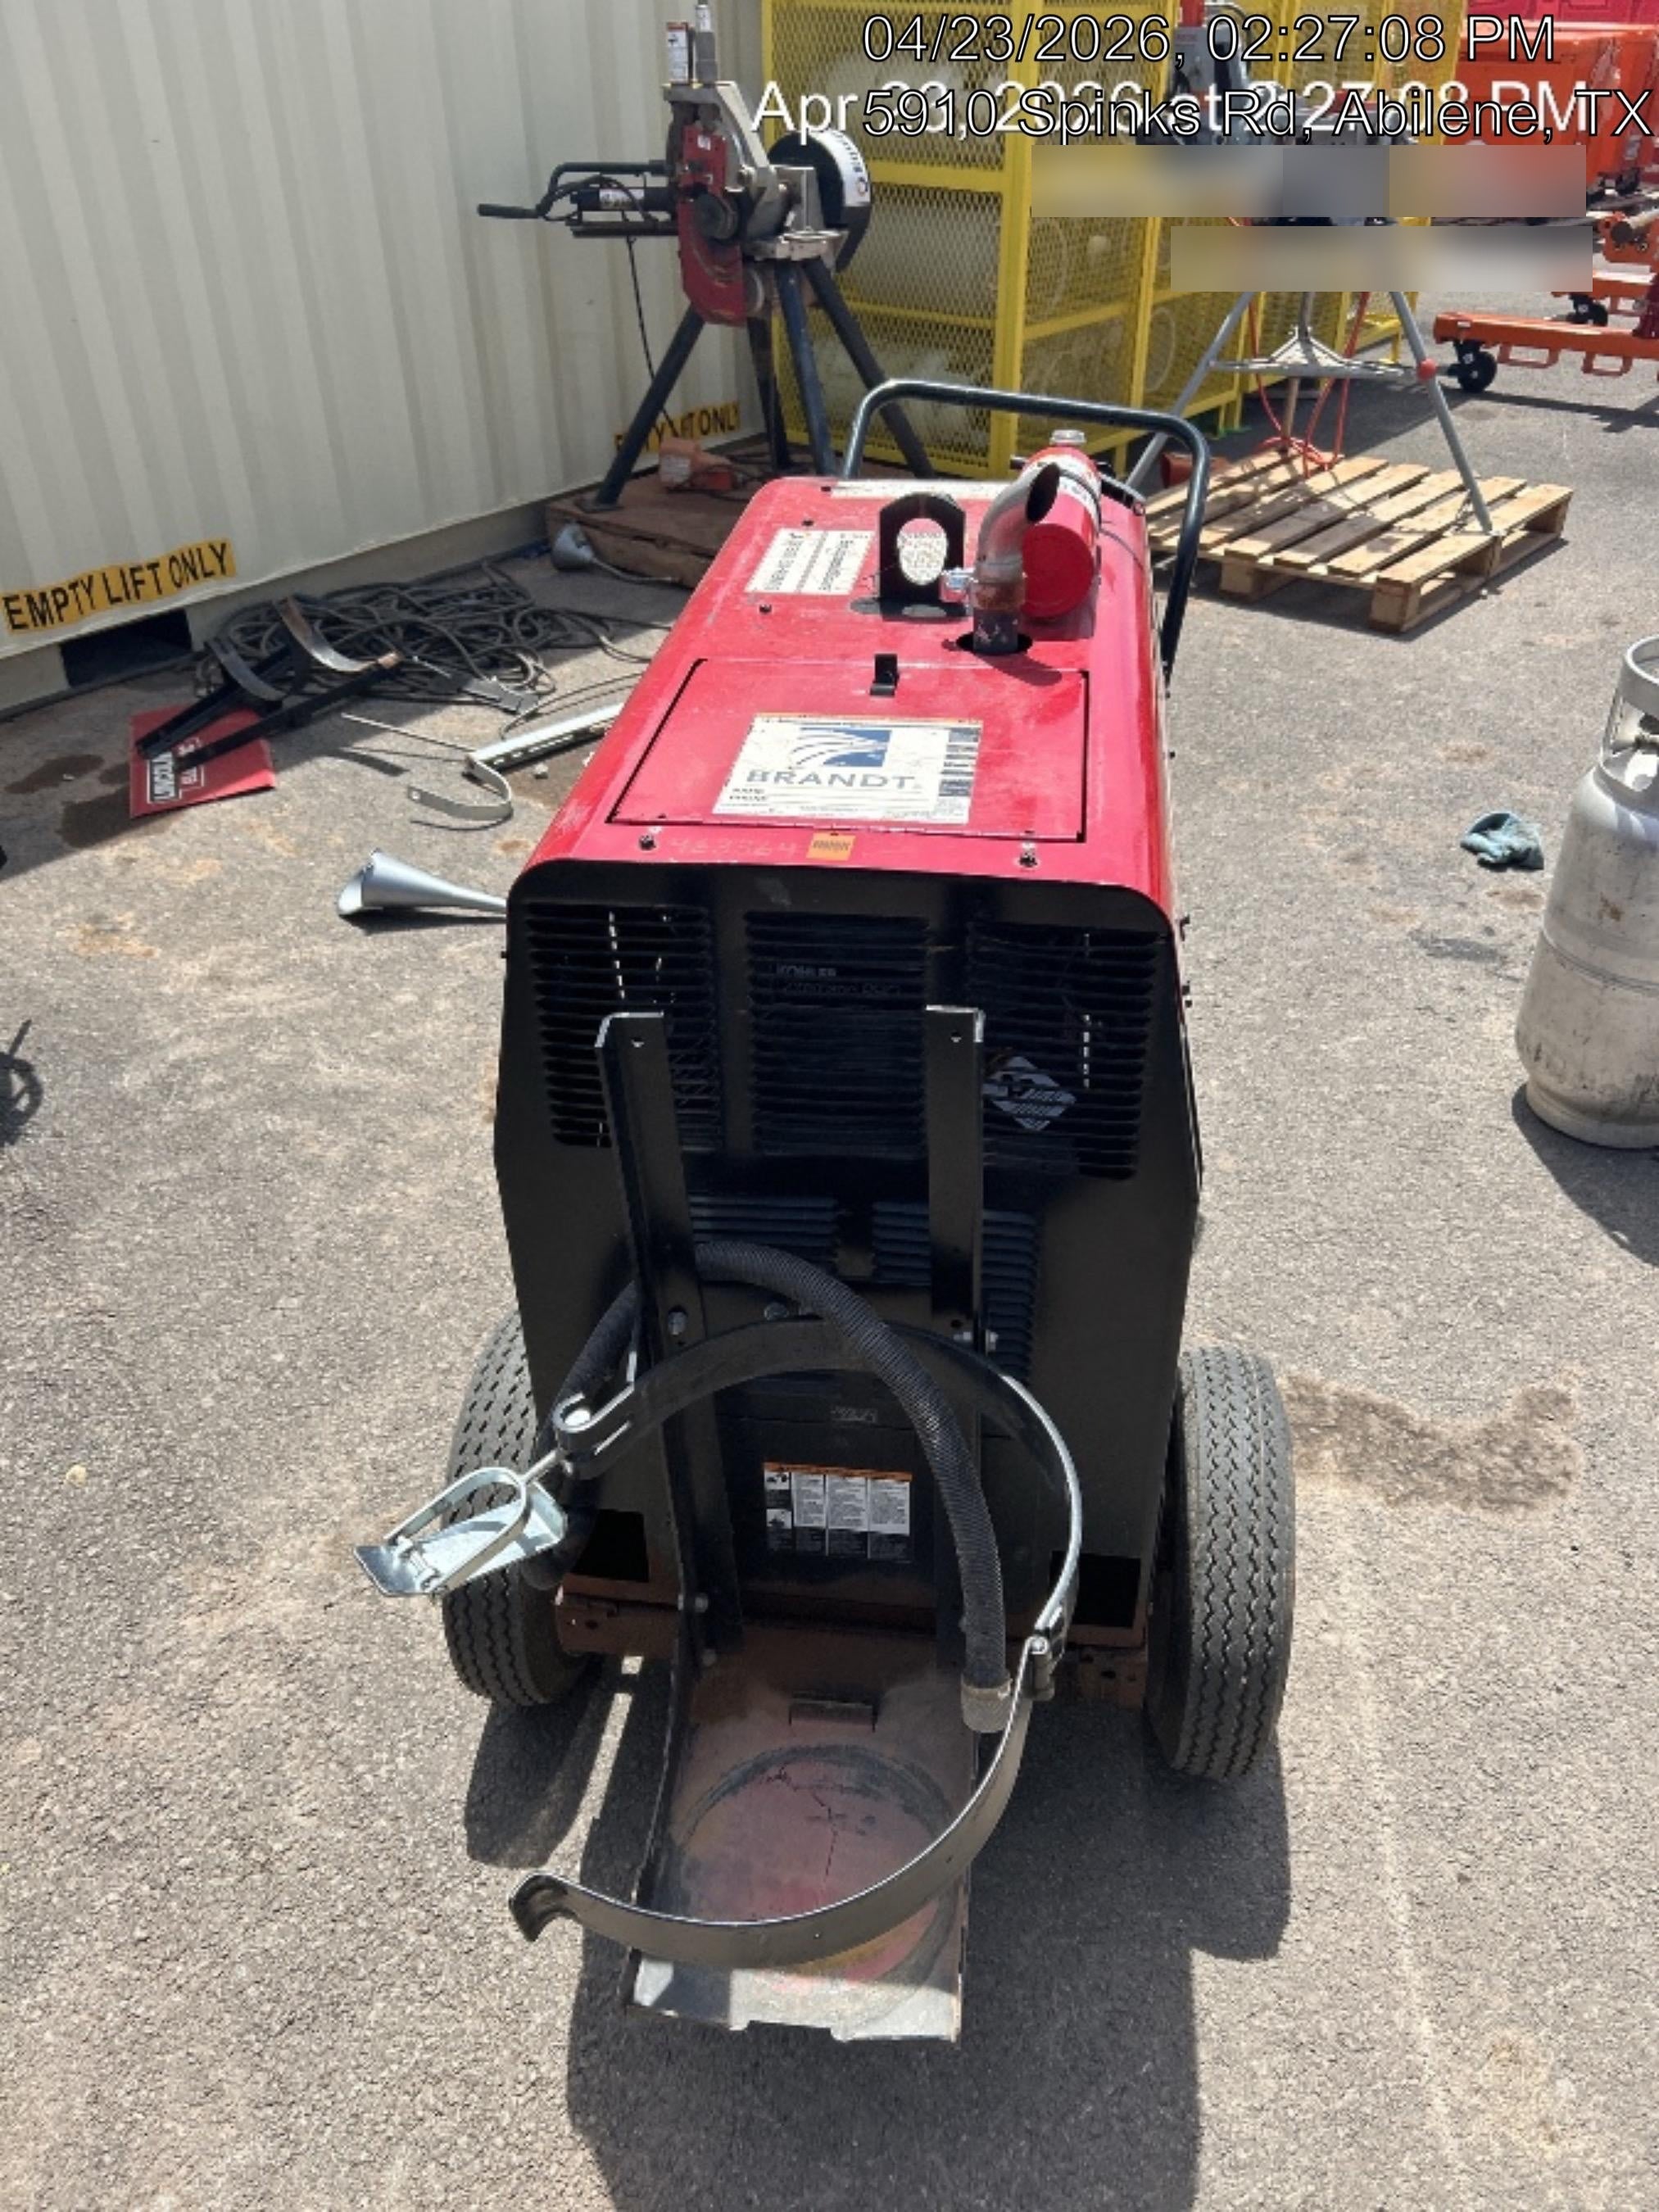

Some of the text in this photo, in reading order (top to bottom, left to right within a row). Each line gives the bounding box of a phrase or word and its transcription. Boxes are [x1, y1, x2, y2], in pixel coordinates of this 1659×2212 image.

[2, 542, 229, 631] EMPTY LIFT ONLY
[746, 769, 916, 789] BRANDT
